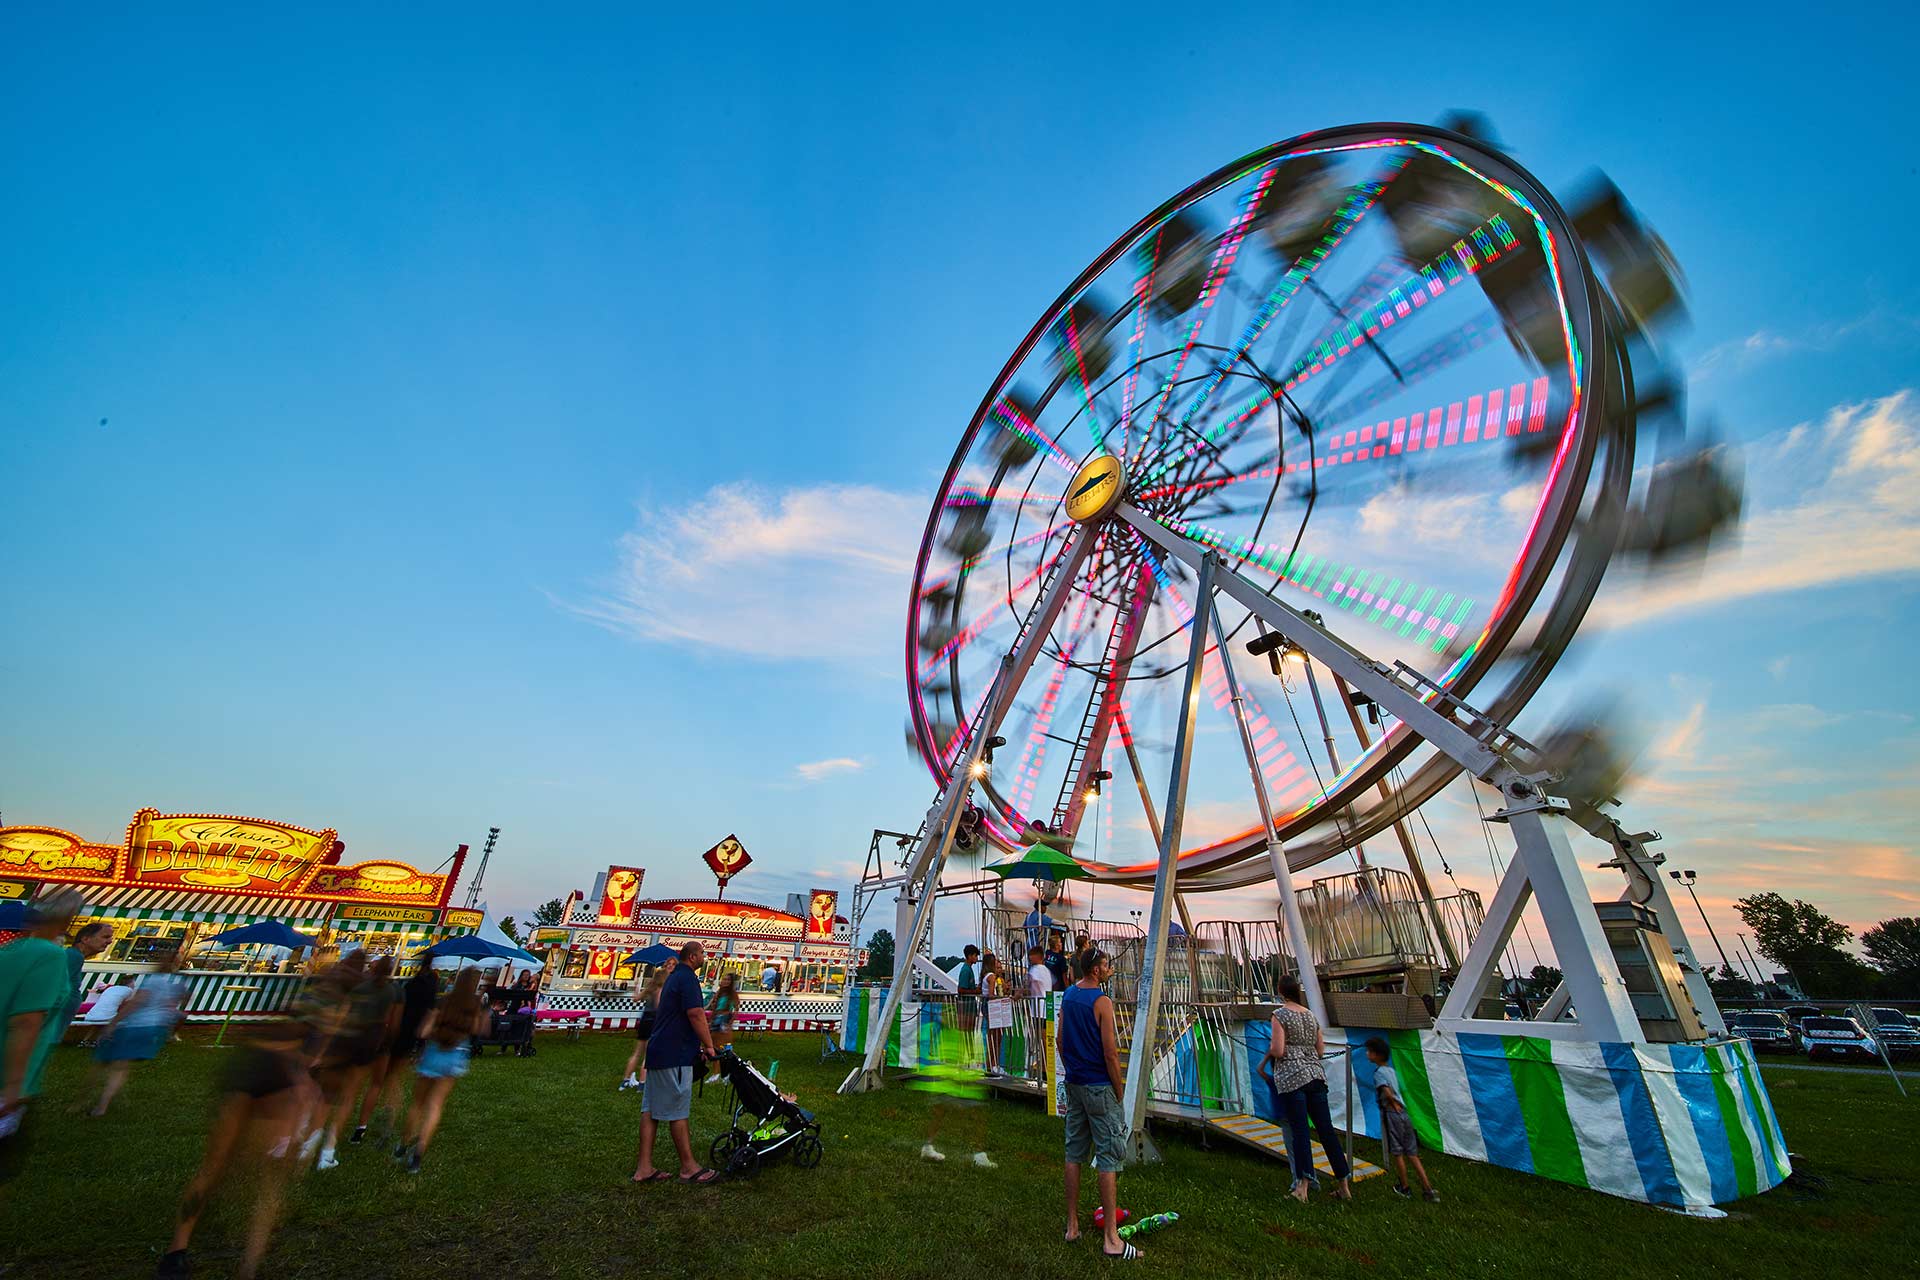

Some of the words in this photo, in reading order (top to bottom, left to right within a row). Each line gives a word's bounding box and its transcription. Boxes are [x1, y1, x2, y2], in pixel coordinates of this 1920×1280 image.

[191, 825, 284, 846] Classic
[32, 849, 112, 872] Cakes
[142, 839, 307, 883] BAKERY
[316, 874, 434, 896] Lemonade
[352, 907, 401, 919] ELEPHANT
[403, 909, 426, 921] EARS
[672, 904, 730, 926] Classic
[599, 933, 622, 944] Corn
[624, 934, 648, 946] Dogs
[745, 942, 760, 951] Hot
[761, 943, 779, 954] Dogs
